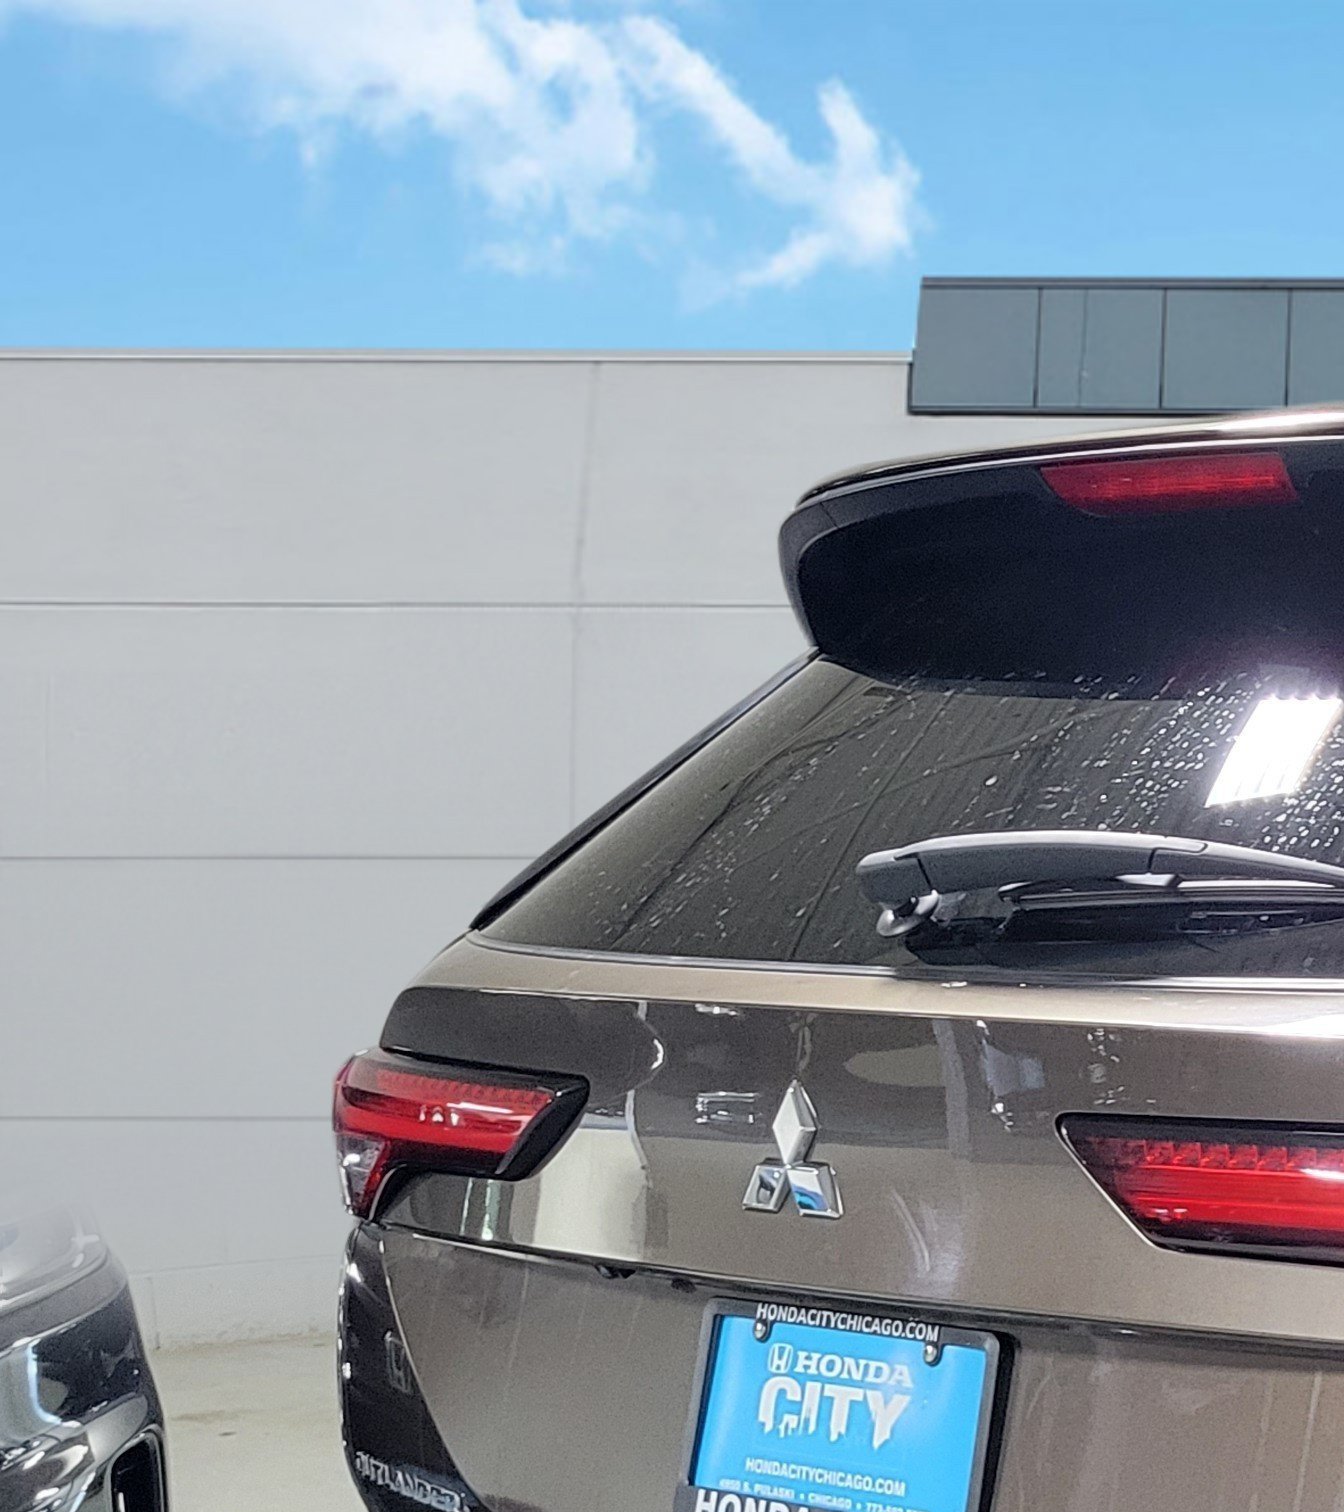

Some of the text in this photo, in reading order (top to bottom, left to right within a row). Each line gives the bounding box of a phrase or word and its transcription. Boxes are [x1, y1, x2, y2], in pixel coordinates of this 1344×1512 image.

[756, 1302, 940, 1342] HONDACITYCHICAGO.COM
[794, 1349, 914, 1388] HONDA
[757, 1375, 910, 1450] CITY
[745, 1457, 906, 1497] HONDACITYCHICAGO.COM
